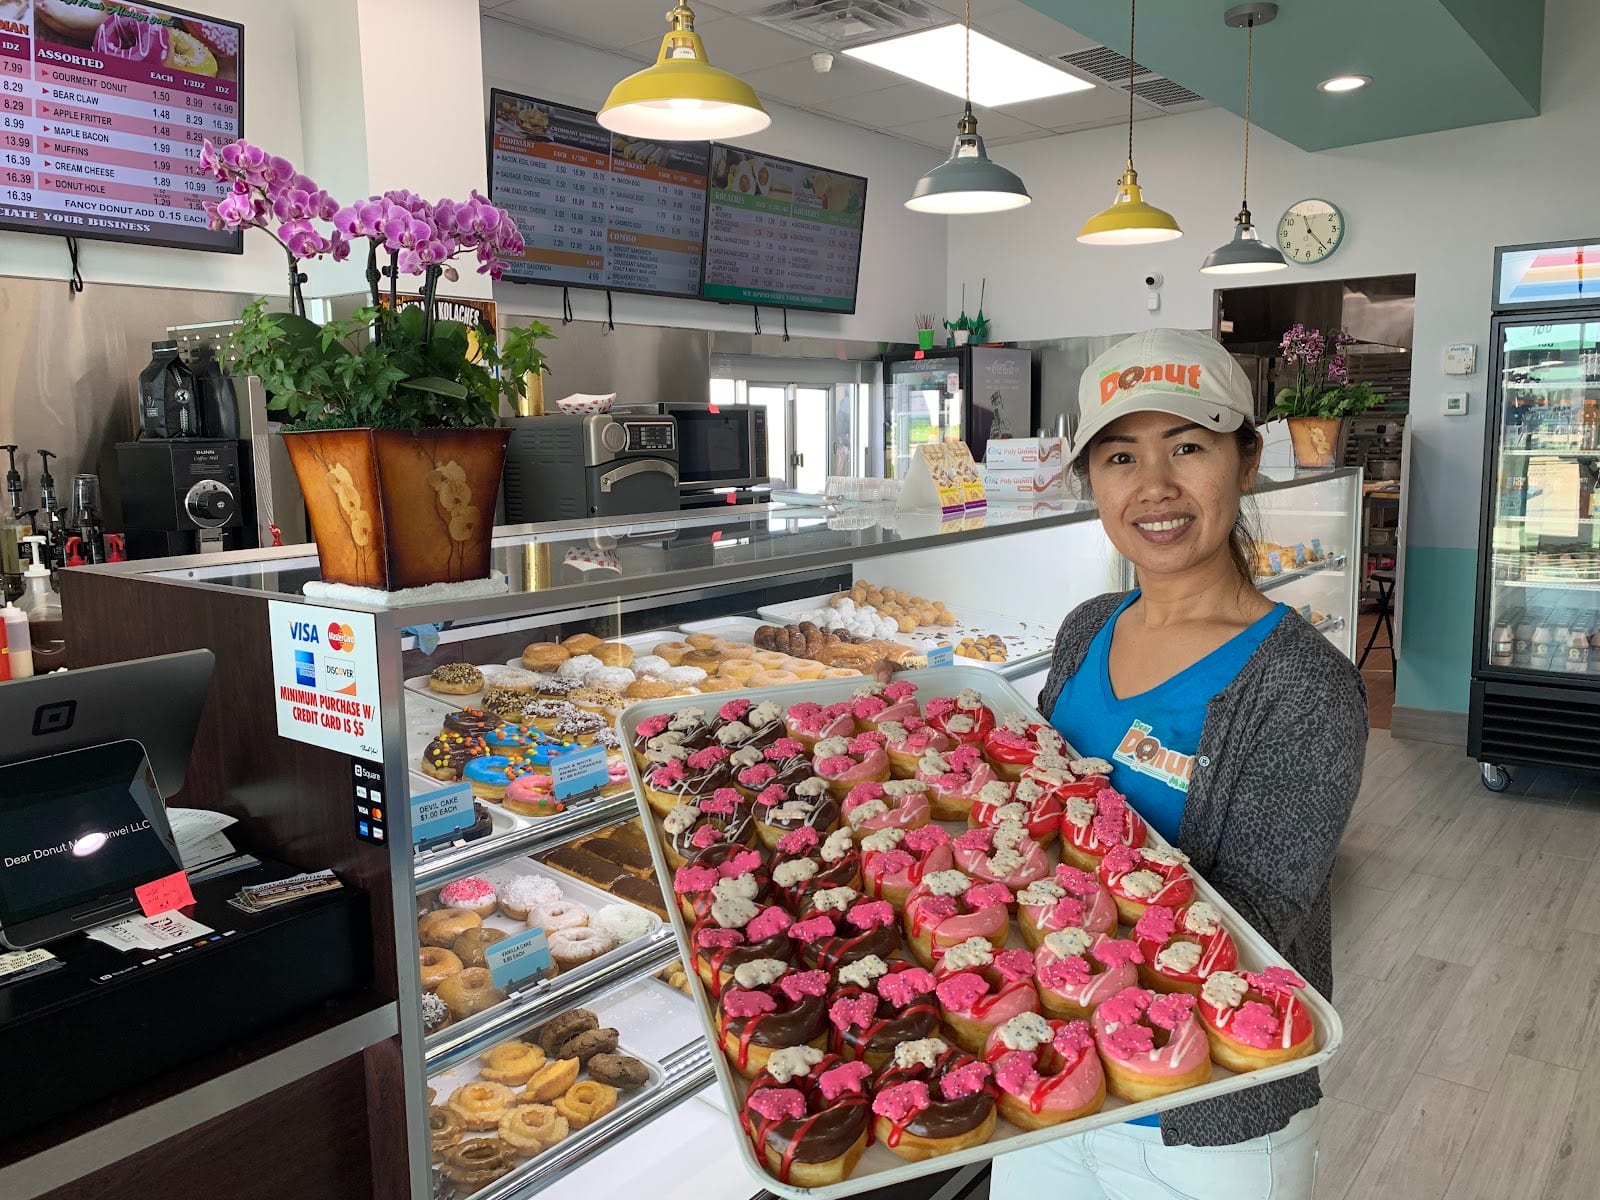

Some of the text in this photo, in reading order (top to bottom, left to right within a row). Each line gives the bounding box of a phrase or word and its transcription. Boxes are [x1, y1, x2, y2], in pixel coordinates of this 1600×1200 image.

[37, 48, 104, 69] ASSORTED
[4, 61, 23, 73] 7.99
[150, 72, 174, 83] EACH
[3, 80, 23, 93] 8.29
[52, 71, 233, 113] GOURMENT DONUT 1.50 8.99 14.99
[4, 99, 24, 111] 8.29
[53, 89, 234, 131] BEAR CLAW 1.48 8.29 16.39
[5, 117, 25, 129] 8.99
[54, 108, 79, 120] APPLE
[80, 112, 112, 126] FRITTER
[153, 125, 170, 137] 1.48
[186, 131, 203, 142] 8.29
[5, 135, 30, 148] 13.99
[54, 126, 80, 138] MAPLE
[82, 130, 109, 143] BACON
[153, 142, 171, 153] 1.99
[184, 147, 201, 158] 11.2
[499, 135, 535, 149] CROISSANT
[6, 154, 31, 166] 16.39
[54, 143, 89, 156] MUFFINS
[153, 160, 171, 171] 1.99
[529, 161, 547, 170] CHEESE
[6, 172, 31, 184] 16.39
[54, 161, 206, 191] CREAM CHEESE 1.89 10.99
[55, 179, 84, 191] DONUT
[85, 184, 106, 194] HOLE
[7, 190, 32, 202] 16.39
[523, 191, 541, 199] CHEESE
[64, 199, 207, 224] FANCY DONUT ADD 0.15 EACH
[1328, 213, 1334, 221] 2
[43, 212, 84, 226] YOUR
[88, 217, 151, 232] BUSINESS
[1287, 218, 1295, 226] 10
[1283, 230, 1288, 238] 9
[1331, 225, 1337, 233] 3
[609, 231, 637, 243] COMBO
[1286, 241, 1291, 249] 8
[1294, 248, 1300, 256] 7
[526, 263, 552, 272] SANDWICH
[438, 301, 480, 327] KOLACHES
[1004, 447, 1016, 456] Poly
[1017, 446, 1038, 454] Gloves
[288, 621, 320, 644] VISA
[326, 664, 354, 678] DISCOVER
[280, 685, 376, 722] MINIMUM PURCHASE W/
[292, 706, 365, 737] CREDIT CARD IS $5
[1133, 720, 1152, 733] Dear
[362, 768, 381, 781] Square
[419, 796, 459, 814] DEVIL CAKE
[420, 805, 458, 821] $1.00 EACH
[4, 853, 31, 868] Dear
[33, 841, 68, 860] Donut
[130, 820, 151, 833] LLC
[501, 940, 532, 957] VANILLA CAKE
